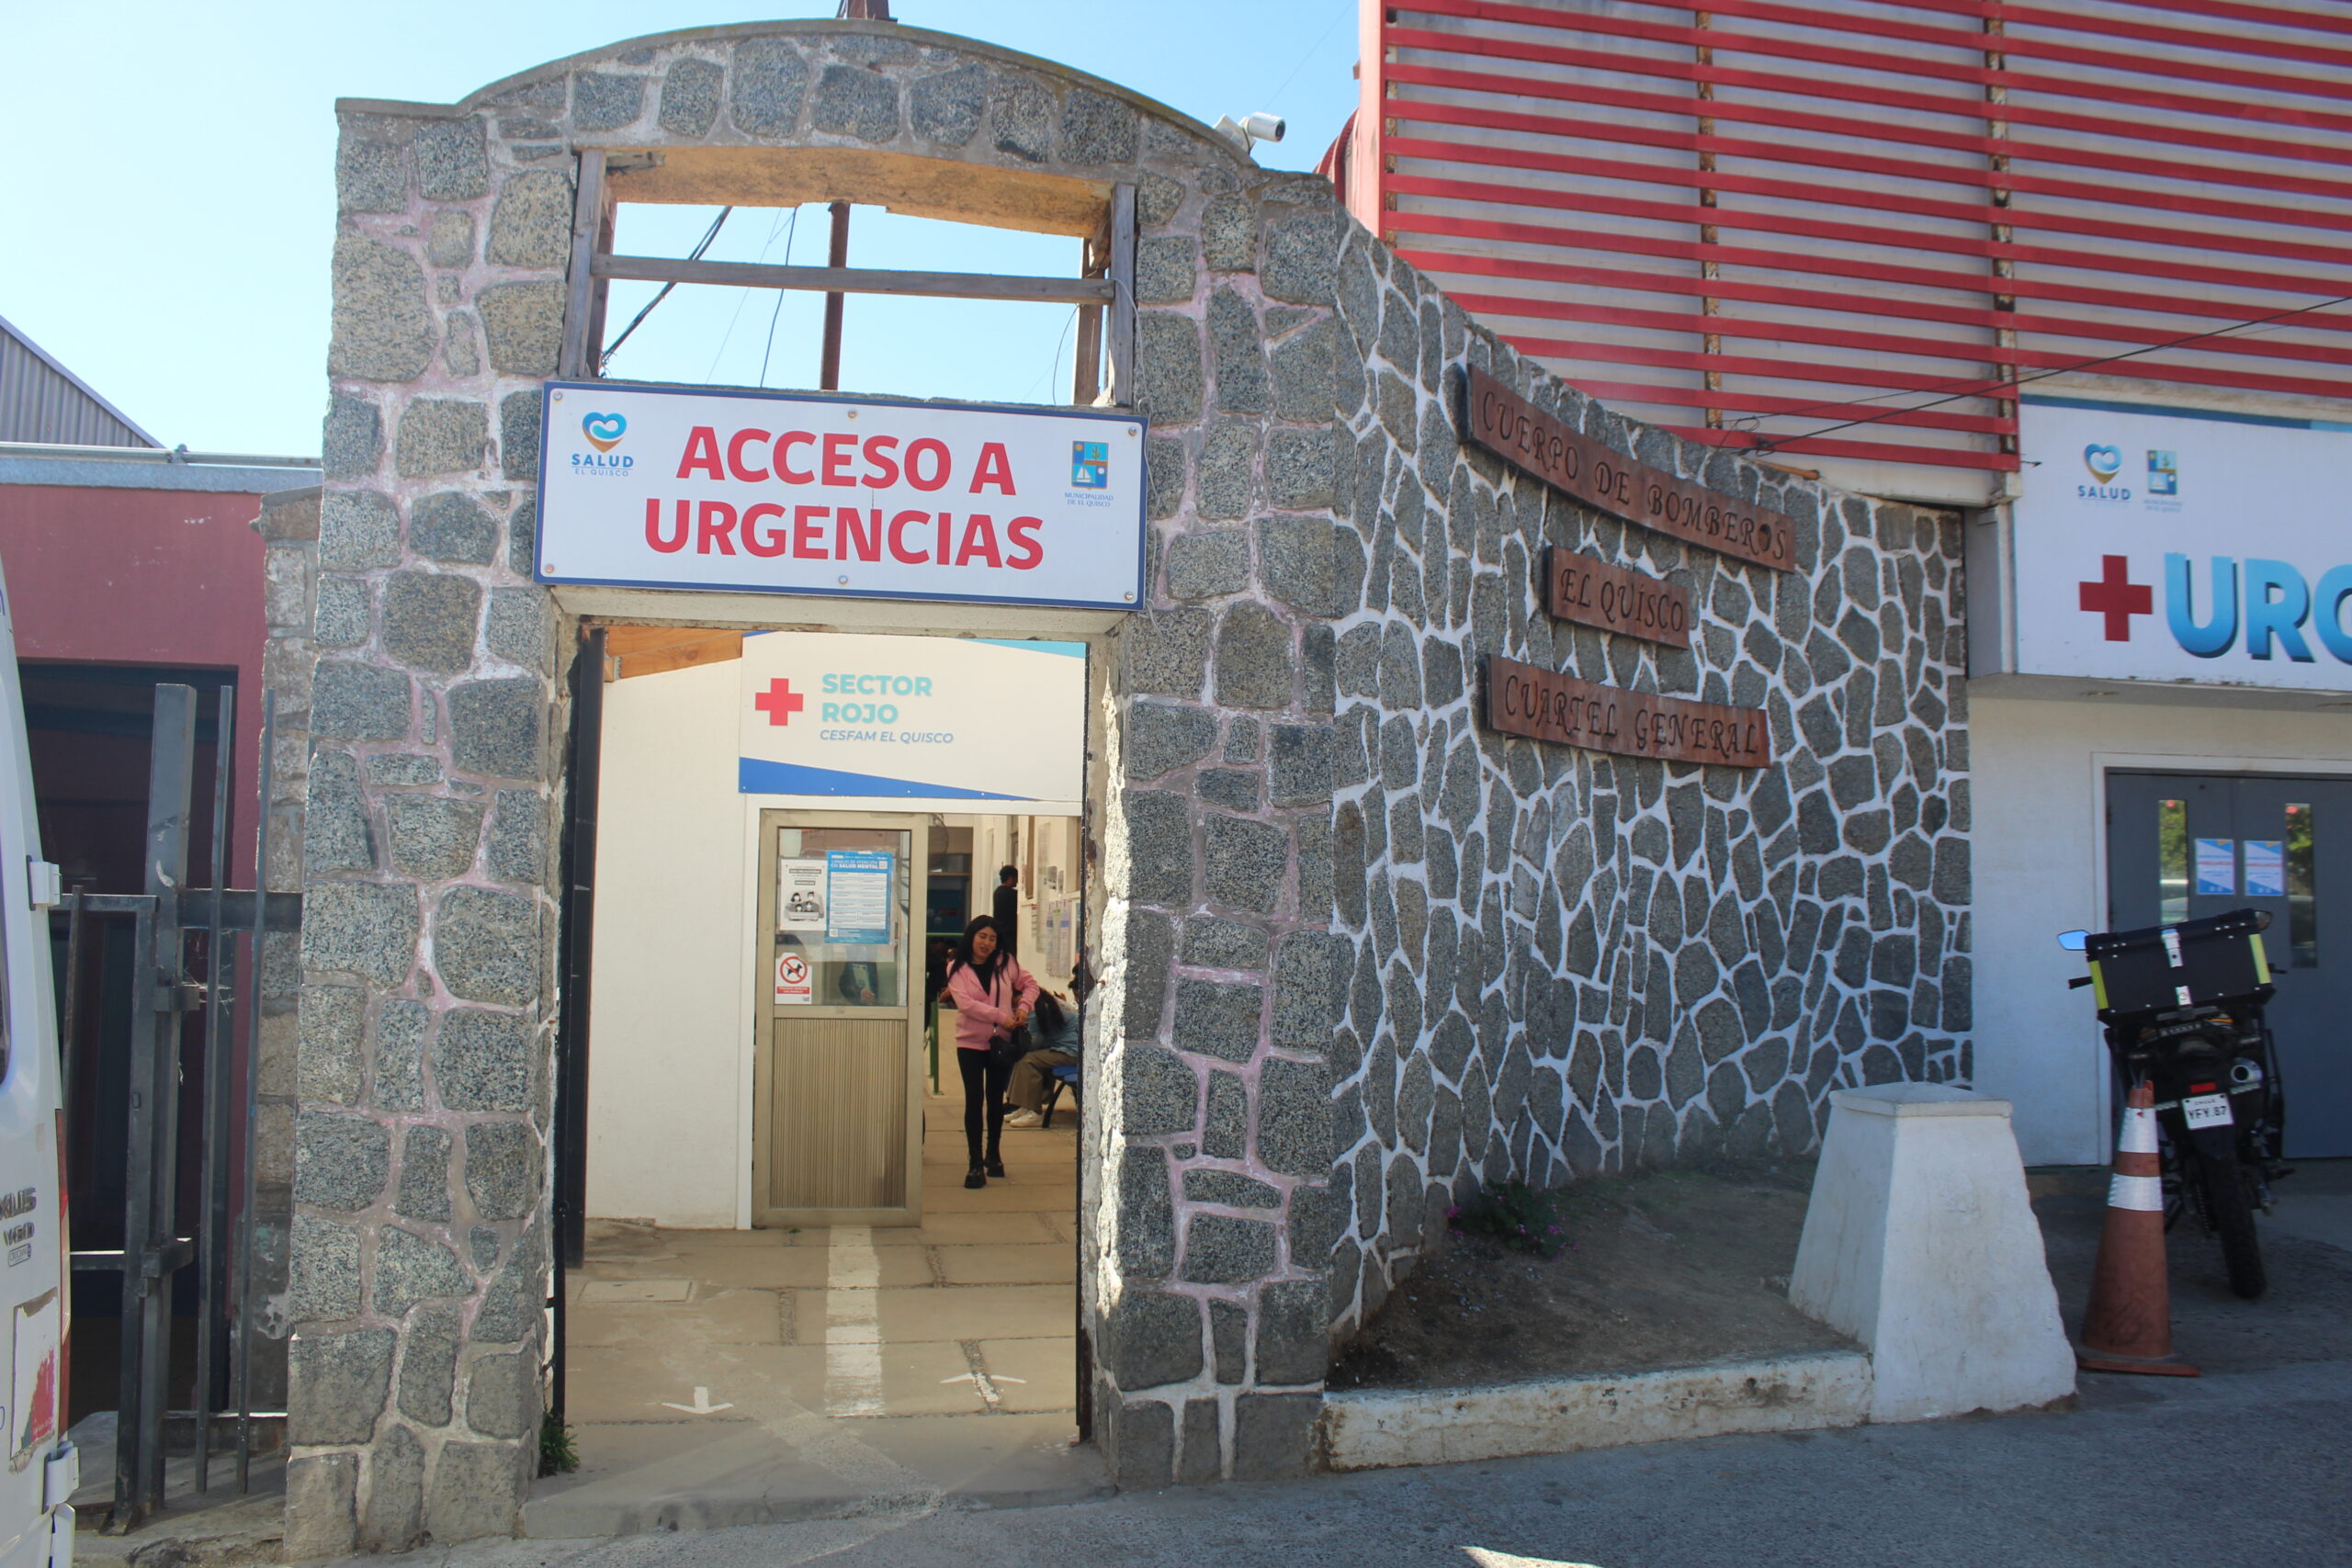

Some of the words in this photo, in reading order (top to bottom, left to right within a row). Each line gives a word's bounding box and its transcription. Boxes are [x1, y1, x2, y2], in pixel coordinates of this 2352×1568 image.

[571, 453, 634, 468] SALUD
[676, 426, 952, 491] ACCESO
[969, 442, 1017, 496] A
[591, 468, 629, 477] QUISCO
[1482, 391, 1578, 479] CUERPO
[1595, 461, 1630, 504] DE
[1647, 484, 1786, 560] BOMBEROS
[1064, 492, 1114, 501] MUNICIPALIDAD
[2077, 484, 2132, 501] SALUD
[646, 498, 1044, 570] URGENCIAS
[1560, 568, 1591, 608] EL
[821, 673, 933, 696] SECTOR
[821, 702, 899, 724] ROJO
[1505, 674, 1618, 737] CUARTEL
[1634, 708, 1758, 759] GENERAL
[820, 728, 876, 741] CESFAM
[880, 730, 897, 742] EL
[899, 731, 955, 746] QUISCO
